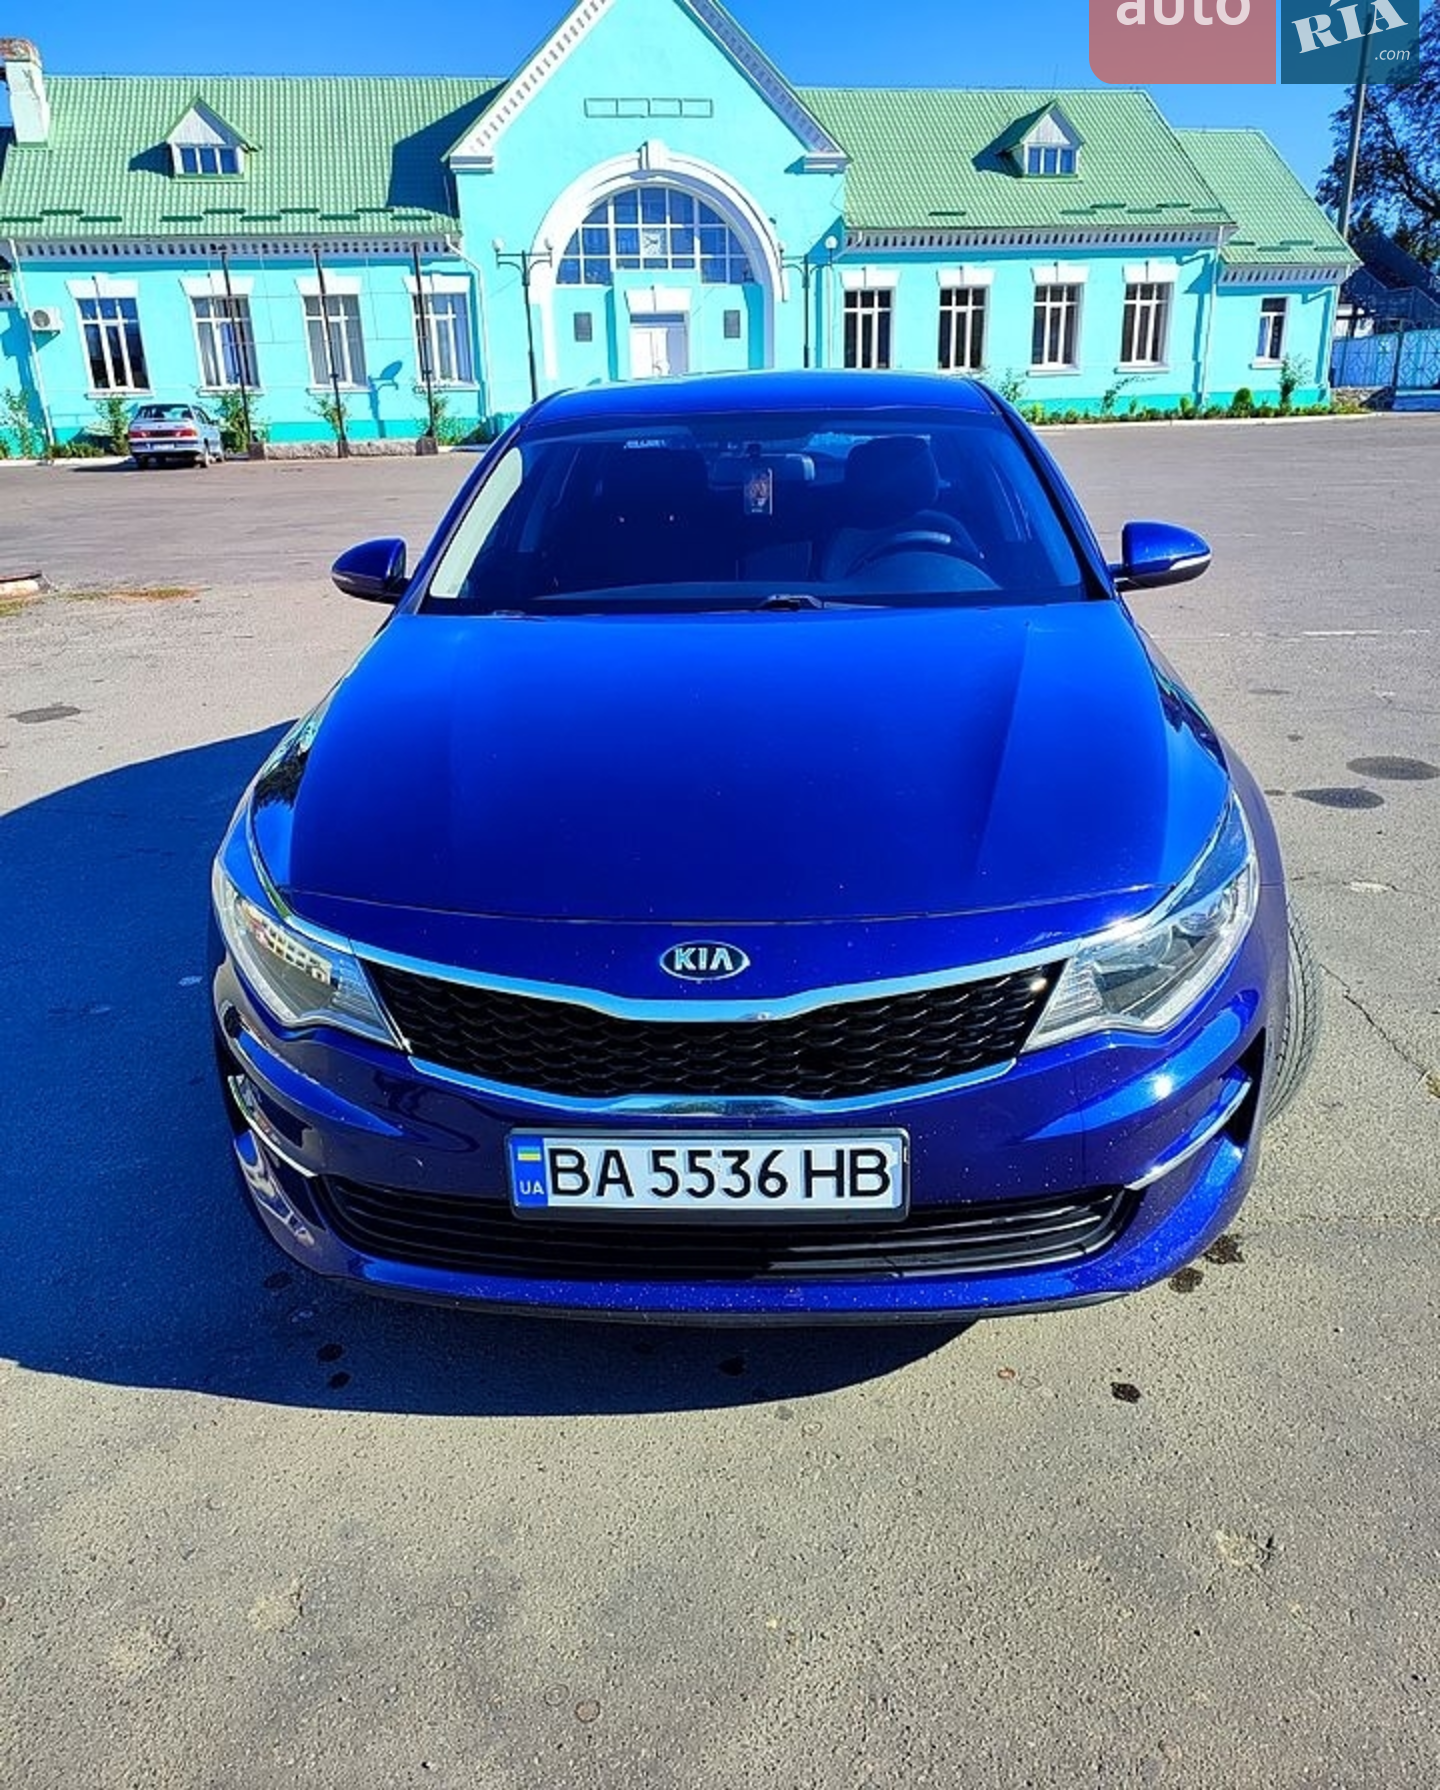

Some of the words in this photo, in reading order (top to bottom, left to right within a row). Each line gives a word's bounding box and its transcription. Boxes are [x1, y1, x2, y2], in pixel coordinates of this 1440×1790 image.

[674, 947, 734, 971] KIA
[548, 1147, 635, 1198] BA
[650, 1148, 789, 1199] 5536
[803, 1147, 892, 1198] HB
[520, 1180, 545, 1197] UA
